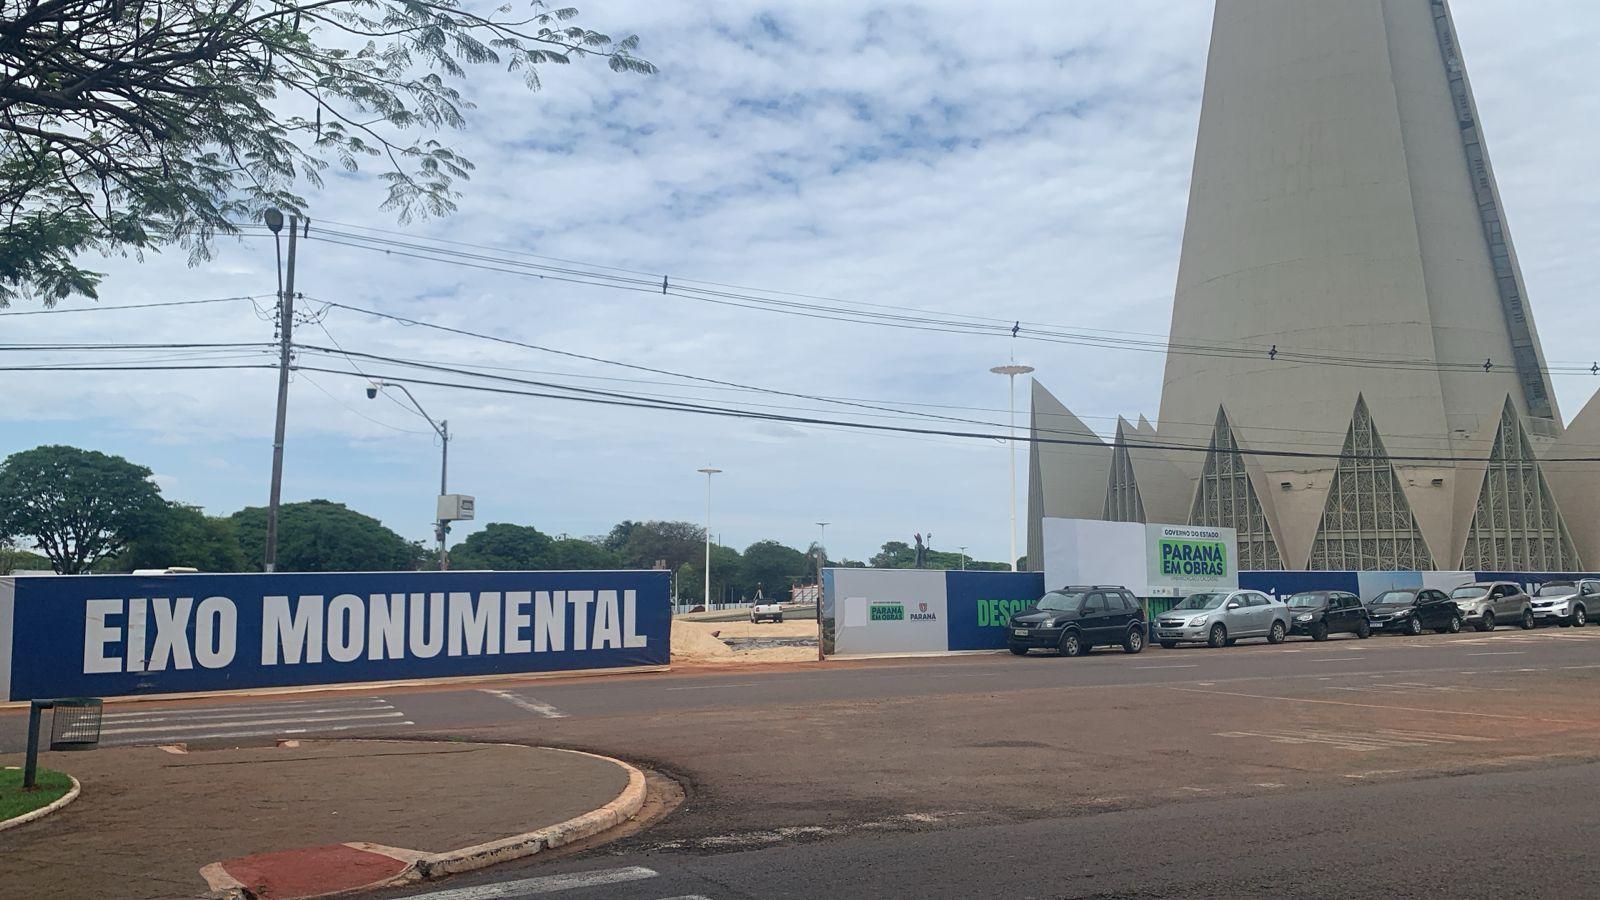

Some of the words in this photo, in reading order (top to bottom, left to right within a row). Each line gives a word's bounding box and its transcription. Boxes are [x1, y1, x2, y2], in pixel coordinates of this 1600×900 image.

[1162, 543, 1223, 561] PARANÁ
[1163, 561, 1181, 574] EM
[1183, 561, 1223, 575] OBRAS
[871, 606, 903, 615] PARANÁ
[910, 612, 936, 620] PARANÁ
[83, 596, 237, 674] EIXO
[261, 589, 648, 666] MONUMENTAL
